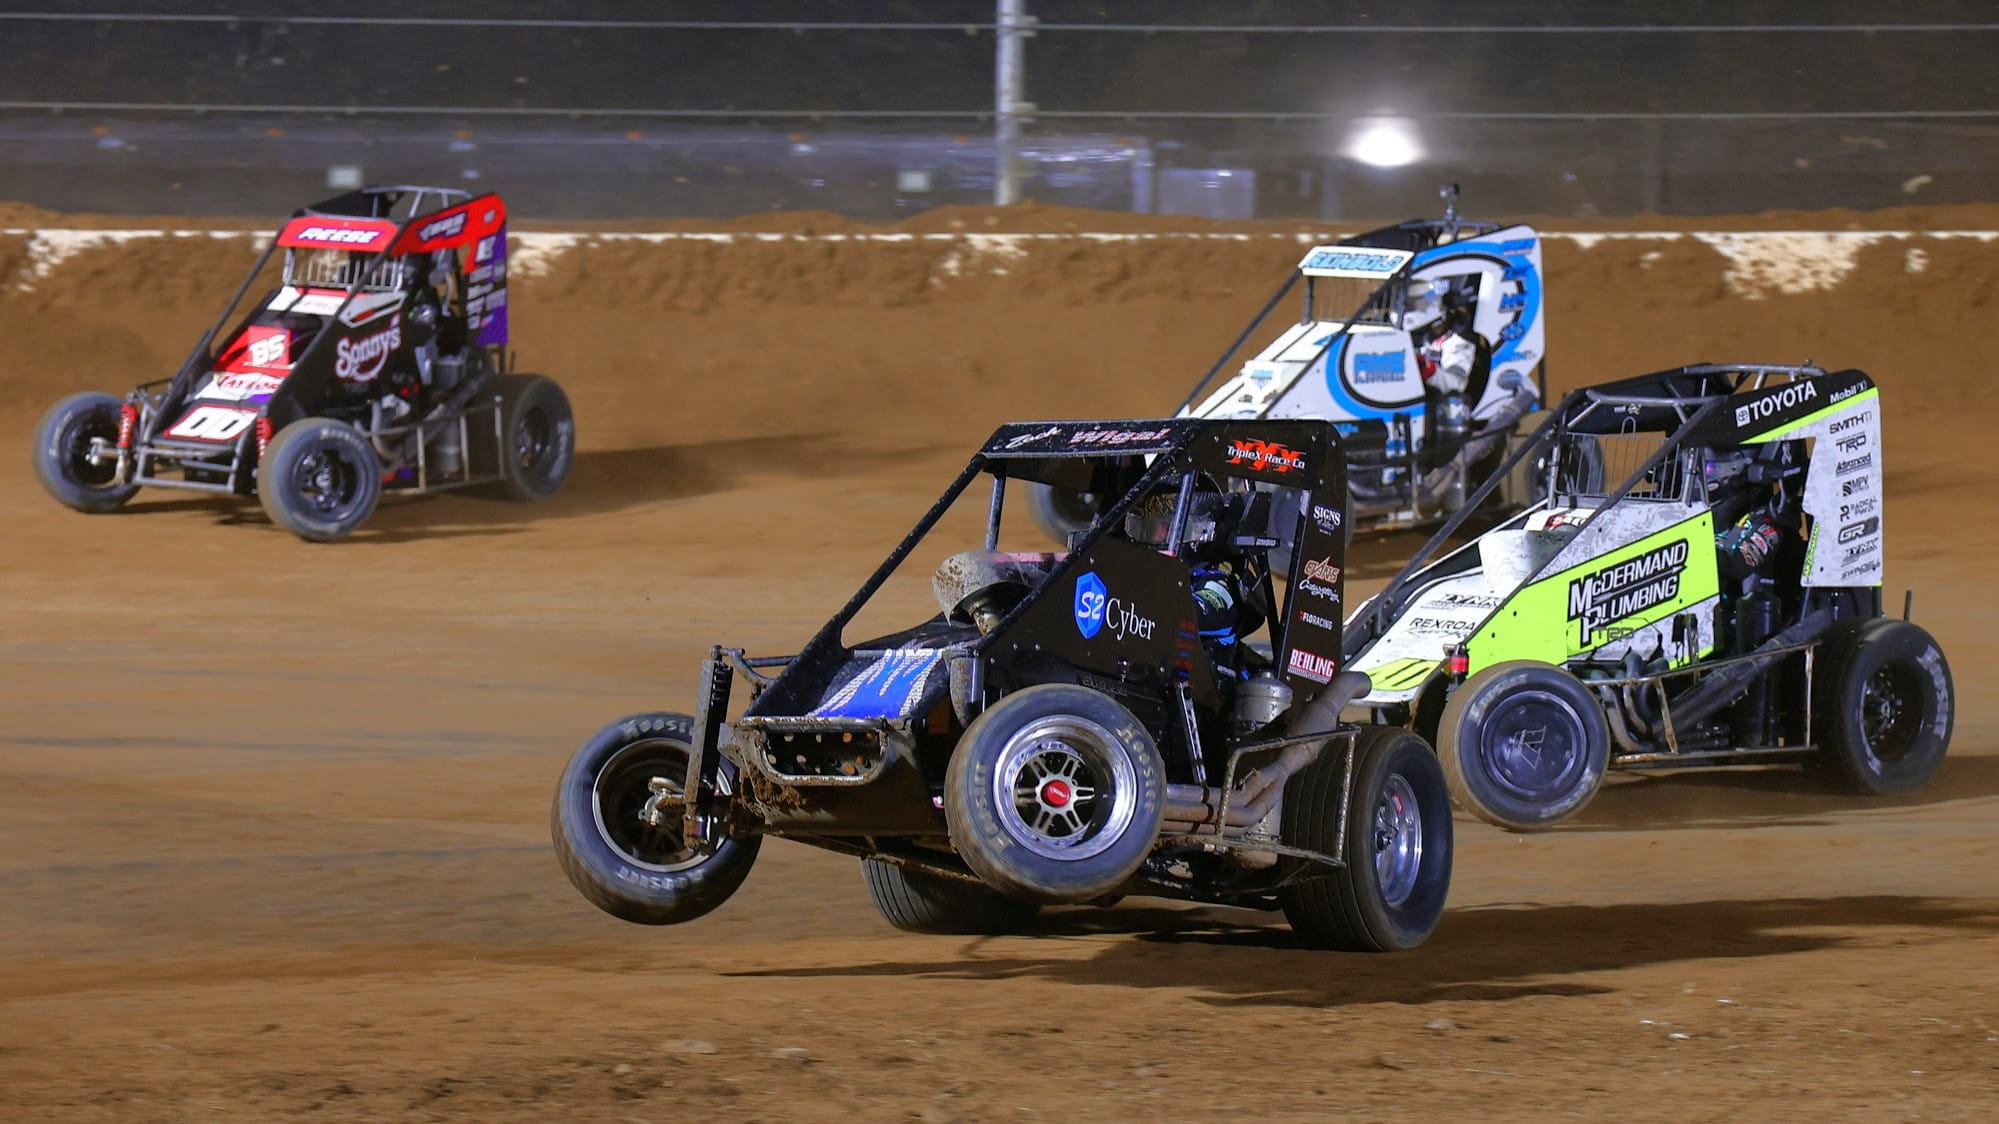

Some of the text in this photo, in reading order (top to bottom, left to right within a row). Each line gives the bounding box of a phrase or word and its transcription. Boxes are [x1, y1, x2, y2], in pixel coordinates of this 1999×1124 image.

[1750, 380, 1818, 420] TOYOTA
[1829, 386, 1857, 404] Mobil
[1836, 434, 1867, 453] TRD
[1226, 445, 1306, 470] TripleX Race Co
[1313, 505, 1341, 526] SIGNS
[1304, 556, 1340, 583] EVANS
[1078, 591, 1156, 640] S2 Cyber
[1302, 611, 1333, 631] FLORACING
[1582, 575, 1679, 644] PLUMBING
[1289, 648, 1335, 677] BEHLING
[622, 718, 694, 741] HOOSI
